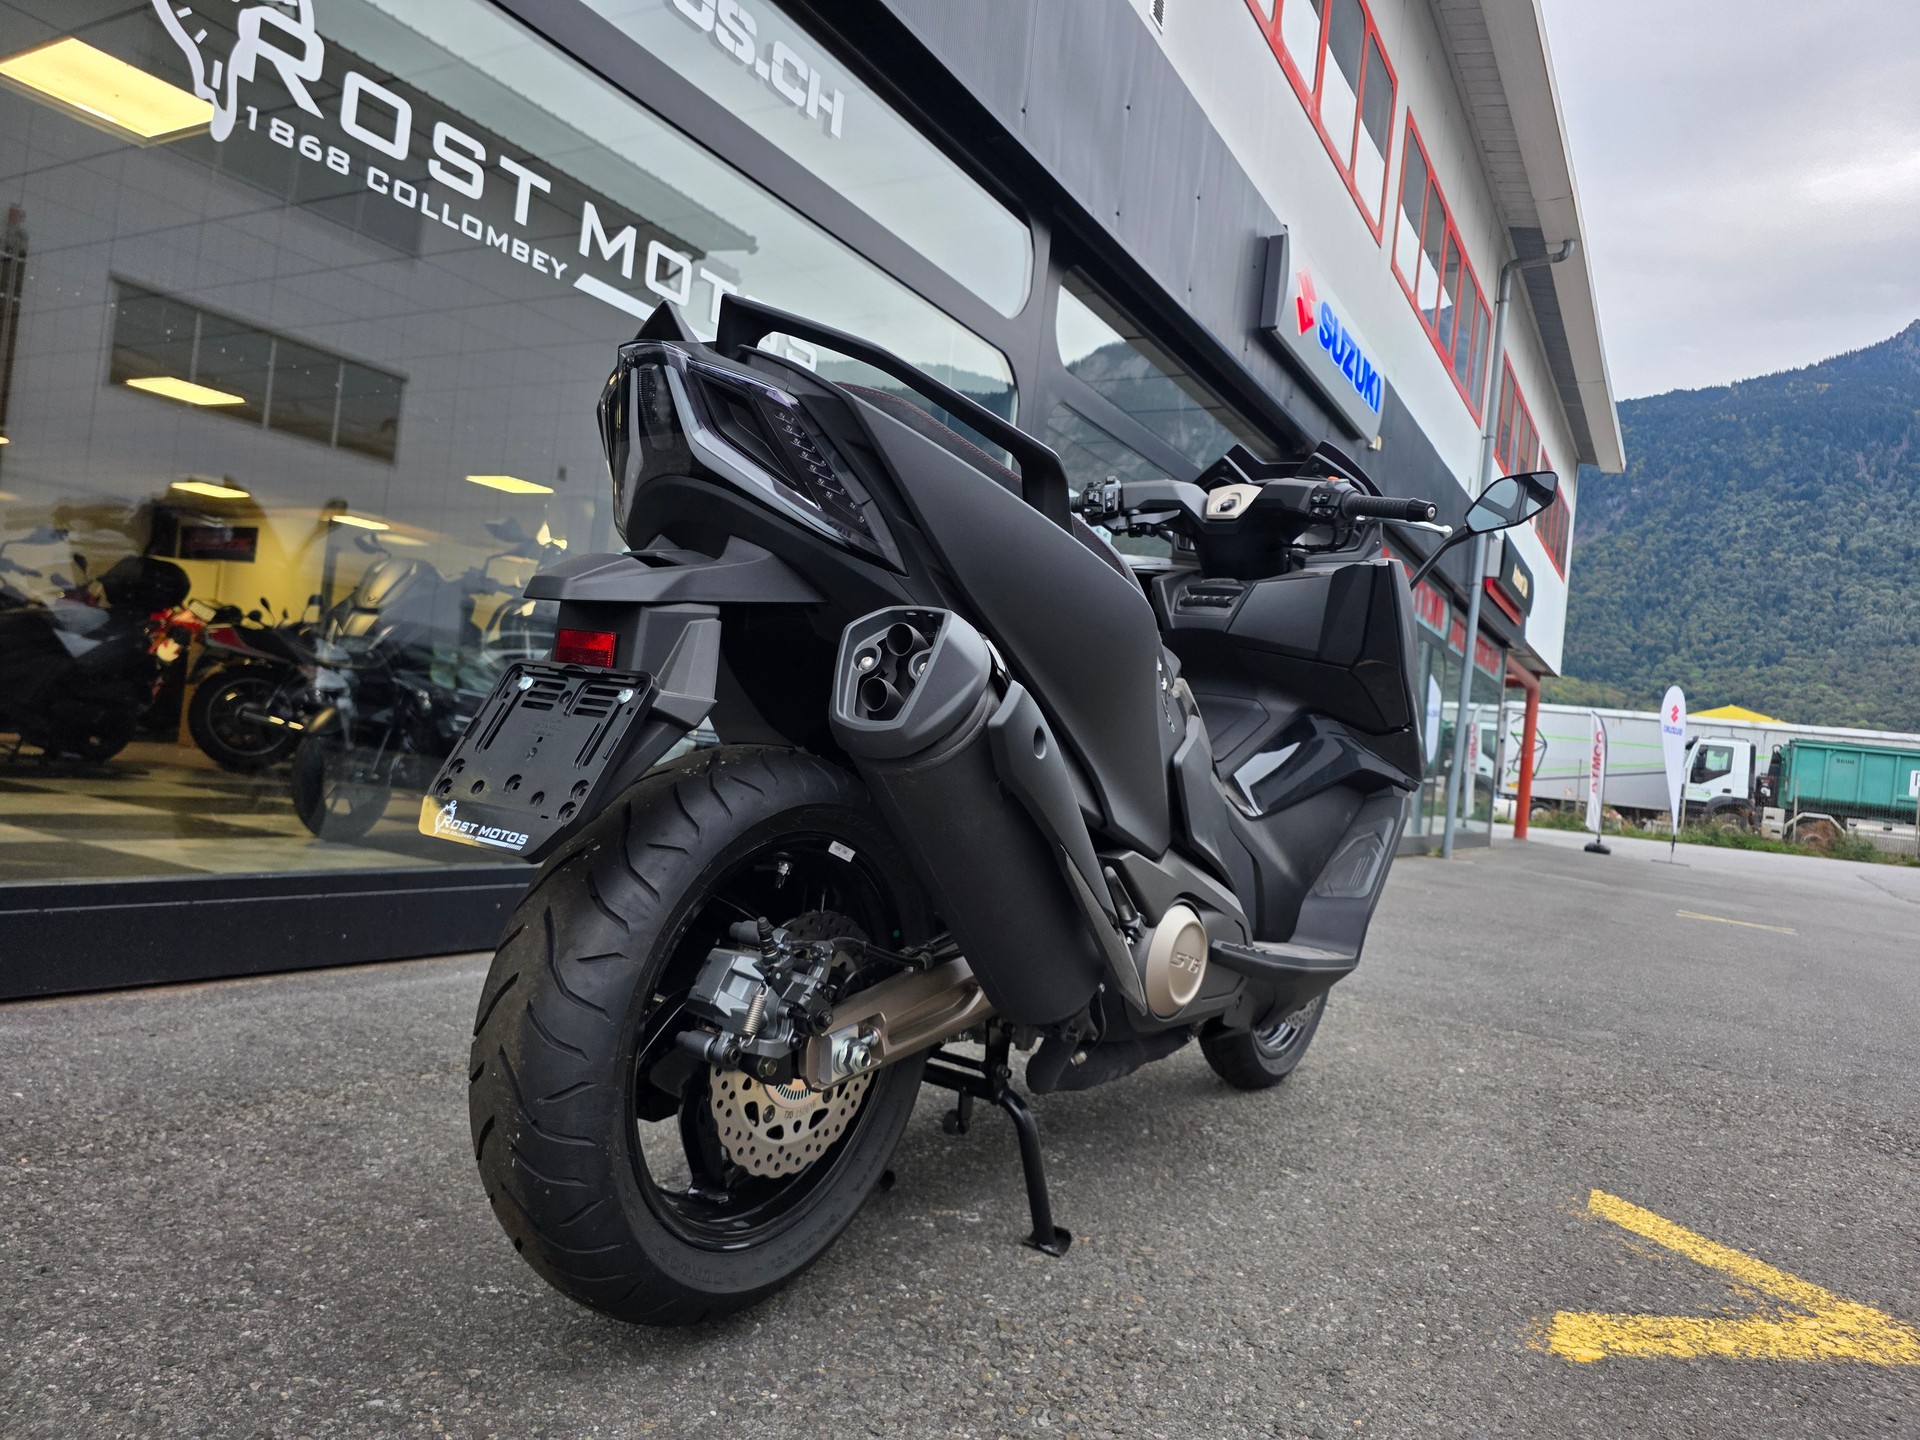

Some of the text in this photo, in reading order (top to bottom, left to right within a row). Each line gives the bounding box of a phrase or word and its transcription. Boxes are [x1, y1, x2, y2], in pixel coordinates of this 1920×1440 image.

[236, 6, 818, 373] ROST MOTS
[246, 105, 569, 281] 1868 COLLOMBEY
[1317, 301, 1382, 414] SUZUKI
[478, 826, 529, 845] MOTOS
